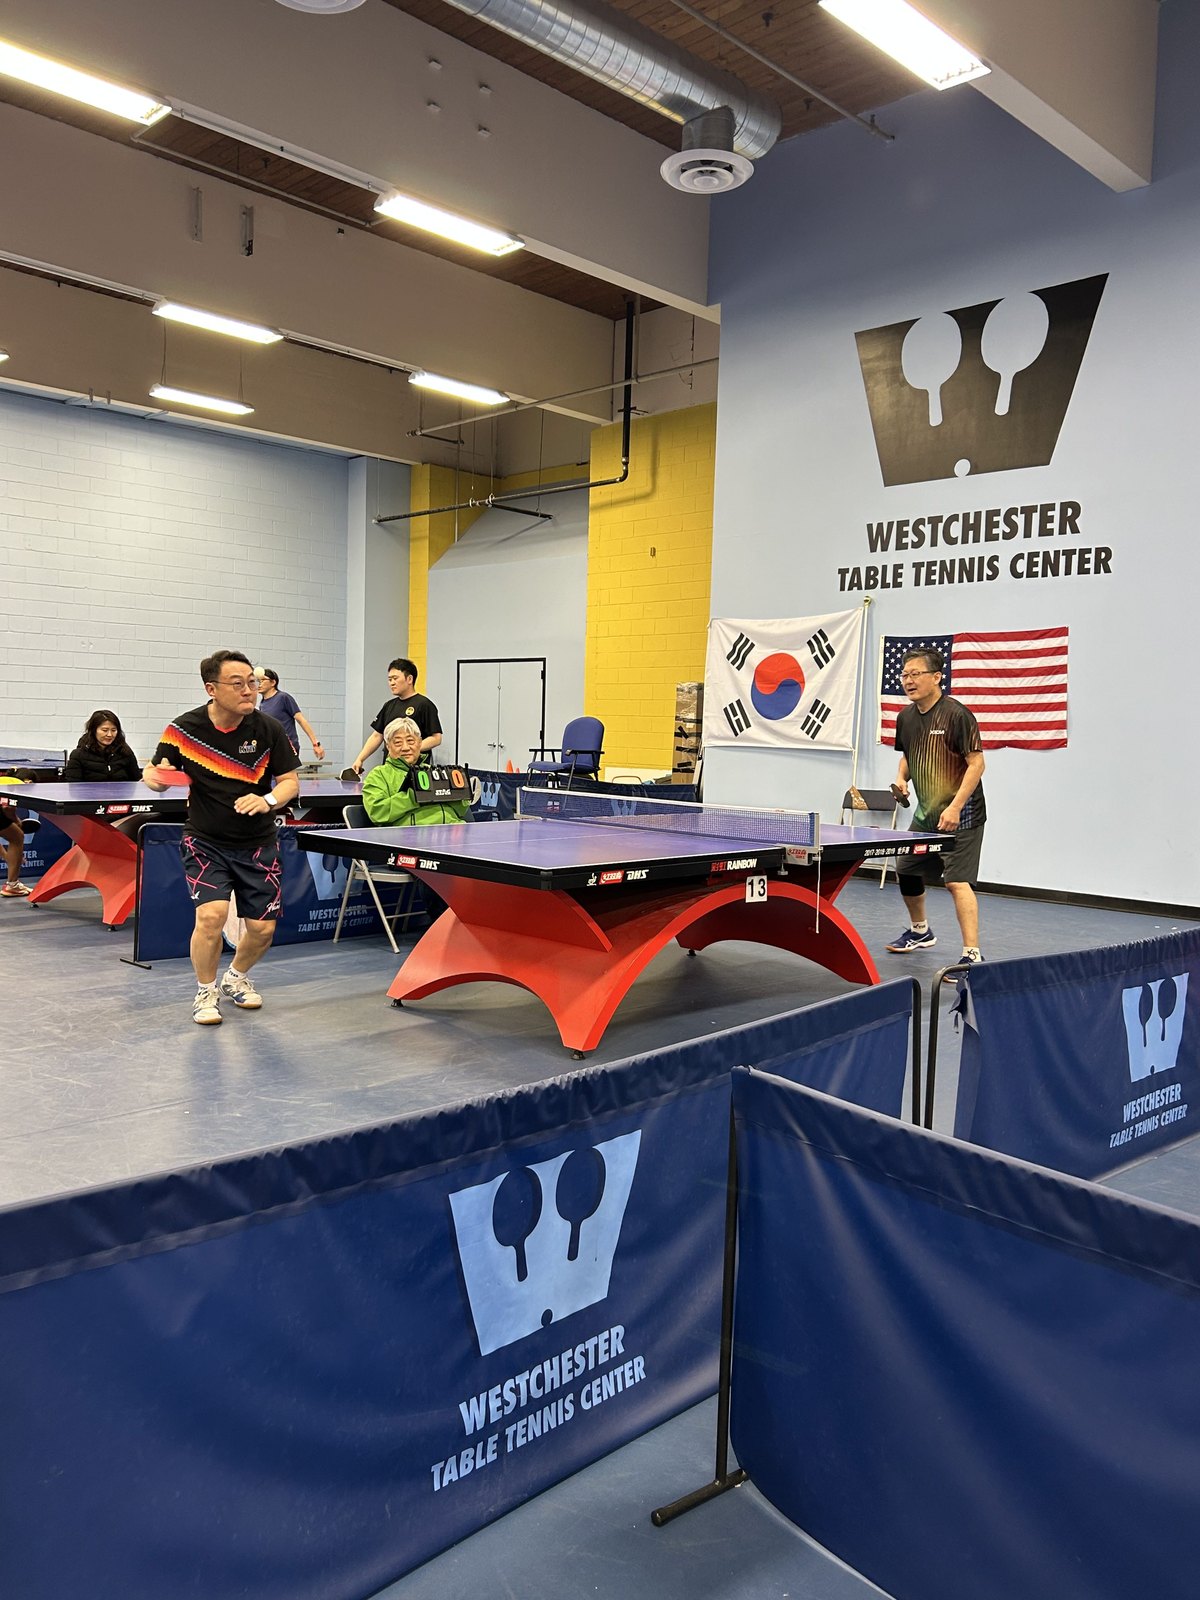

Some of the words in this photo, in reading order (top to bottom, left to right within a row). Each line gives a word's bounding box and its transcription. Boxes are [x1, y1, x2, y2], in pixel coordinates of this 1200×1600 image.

[866, 501, 1082, 553] WESTCHESTER
[838, 564, 904, 591] TABLE
[912, 555, 1000, 587] TENNIS
[1009, 546, 1113, 579] CENTER
[417, 770, 430, 790] 0
[451, 769, 465, 788] 0
[131, 804, 153, 813] DHS
[419, 858, 440, 871] DHS
[727, 858, 757, 871] RAINBOW
[626, 869, 650, 881] DHS
[747, 878, 766, 897] 13
[309, 904, 368, 921] WESTCESTER
[298, 922, 320, 932] TABLE
[322, 920, 347, 930] TENS
[1123, 1083, 1182, 1123] WESTCHESTER
[1109, 1125, 1134, 1148] TABLE
[1134, 1114, 1160, 1138] TENNIS
[1160, 1104, 1188, 1126] CENTER
[458, 1324, 625, 1436] WESTCHESTER
[430, 1433, 499, 1492] TABLE
[505, 1393, 575, 1453] TENNIS
[580, 1355, 647, 1411] CENTER
